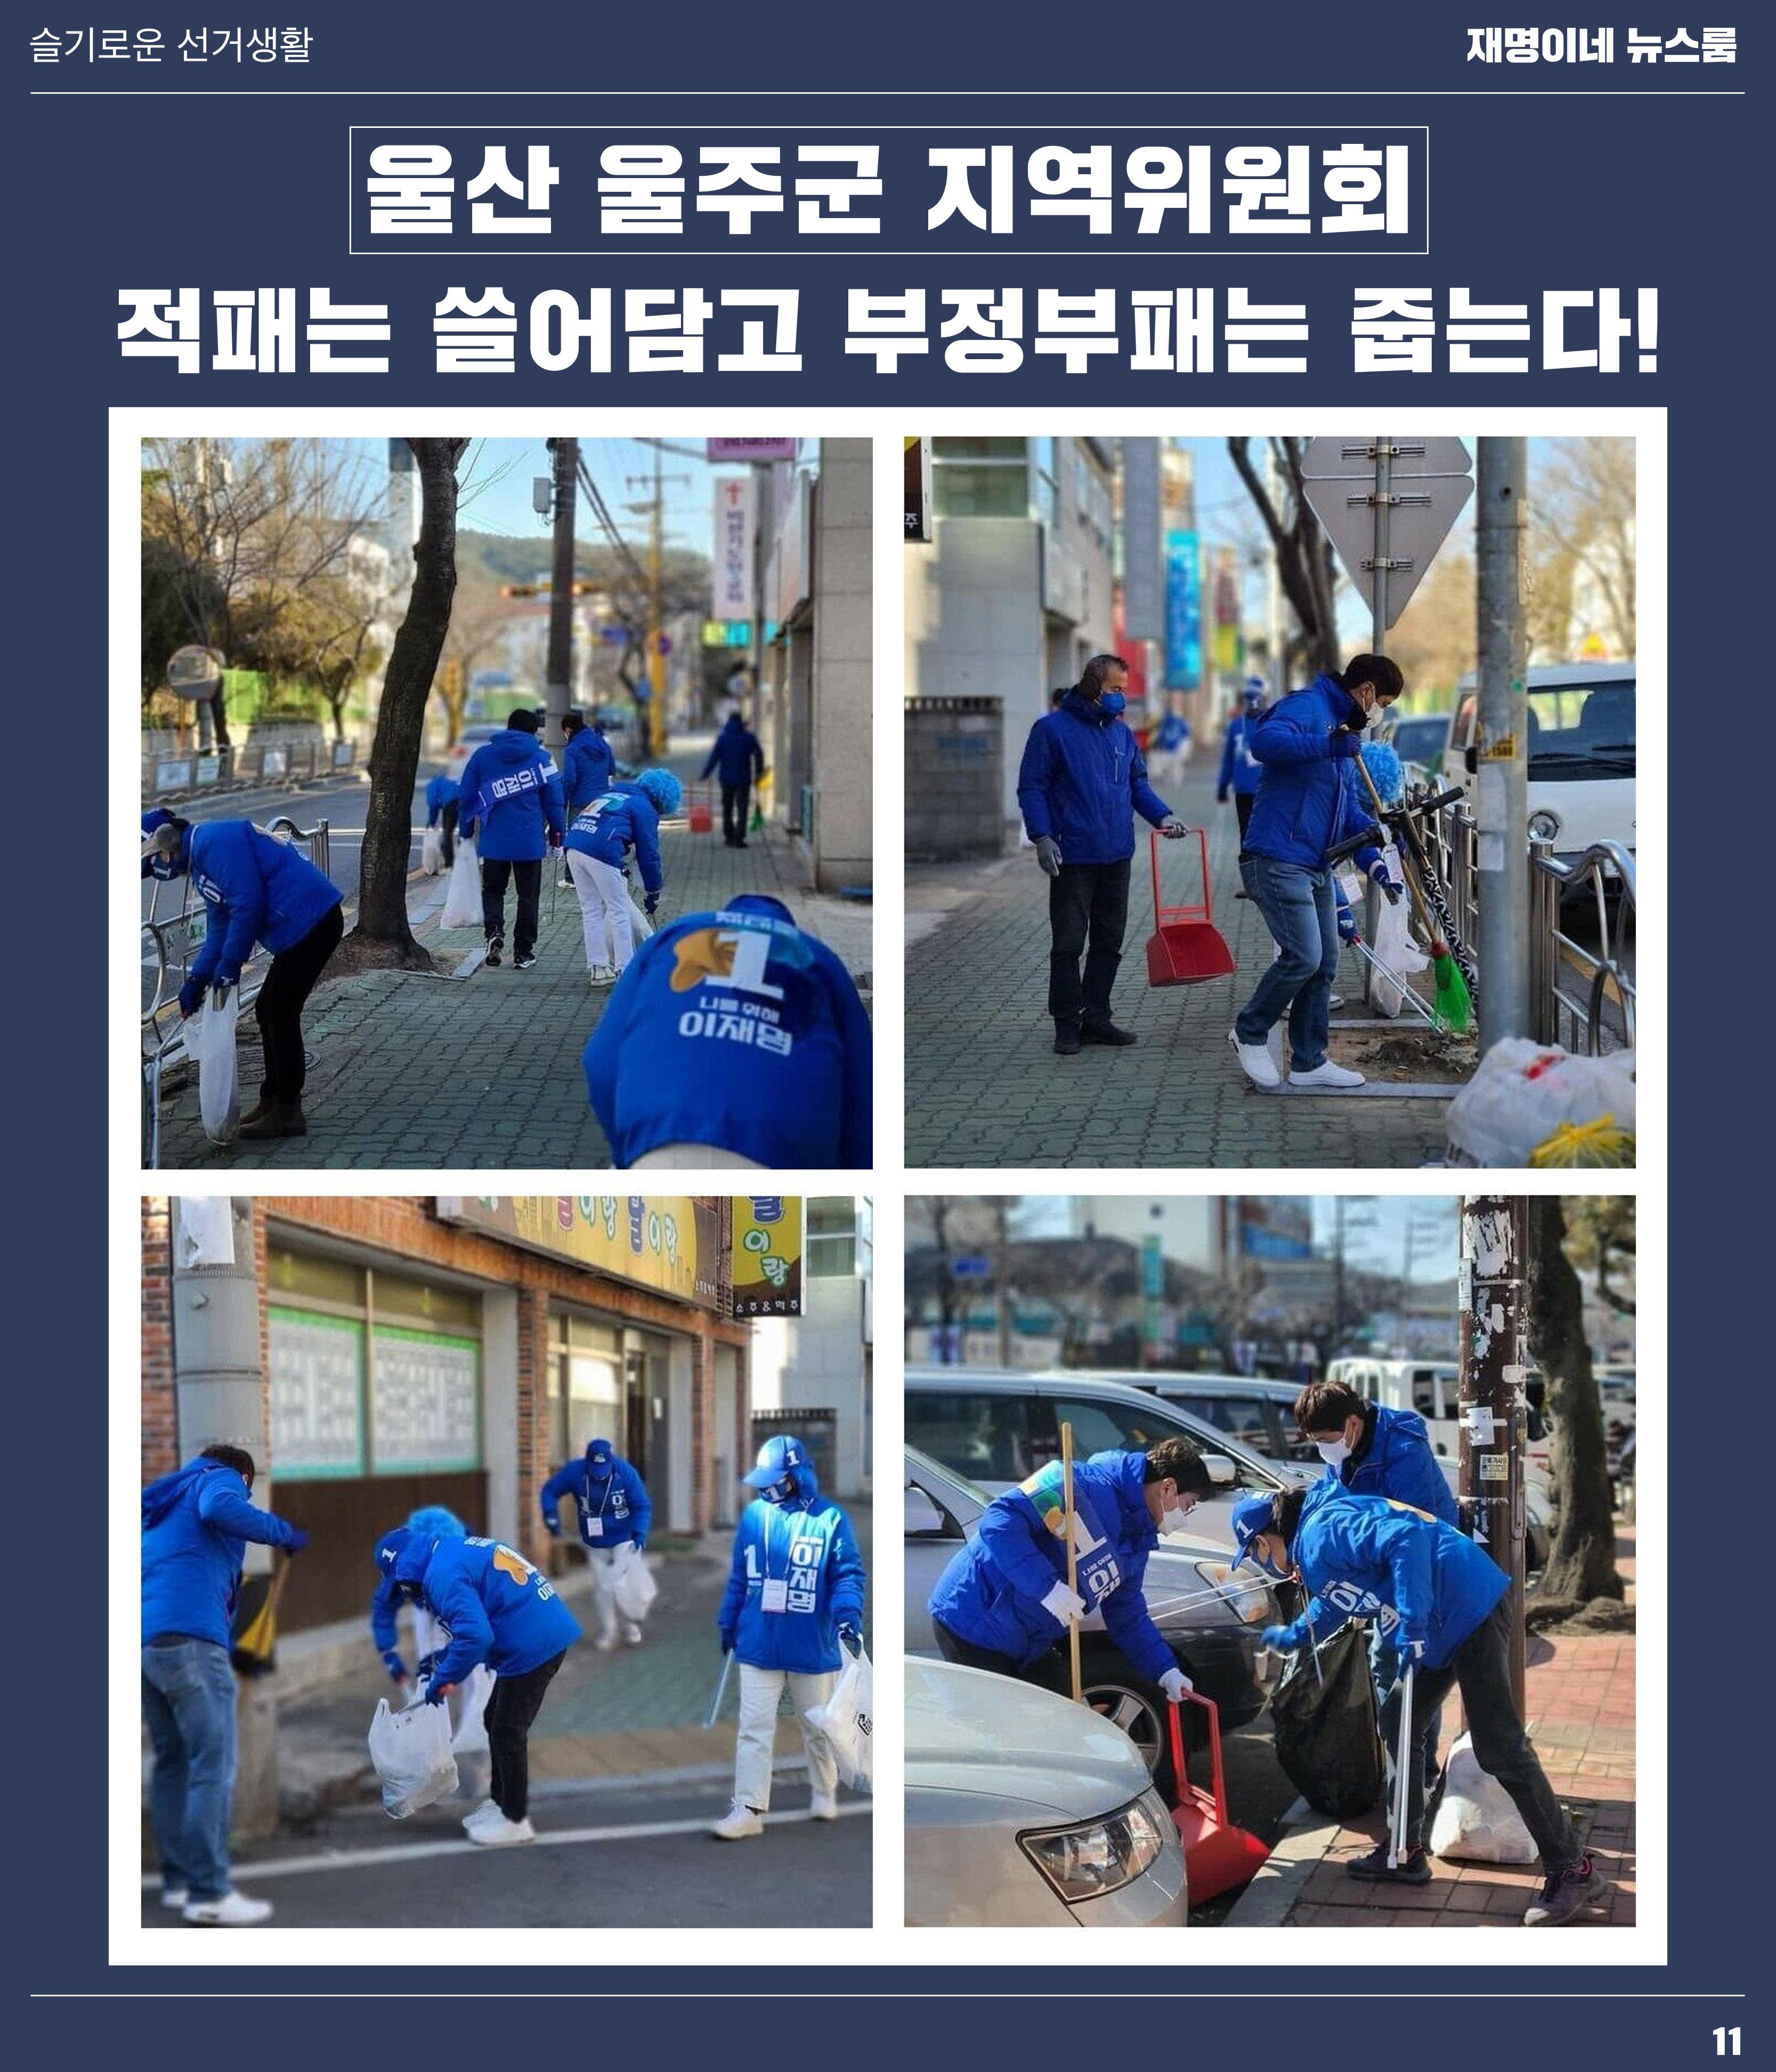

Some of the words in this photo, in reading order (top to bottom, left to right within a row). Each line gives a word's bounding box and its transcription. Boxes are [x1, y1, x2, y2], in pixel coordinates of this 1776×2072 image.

[491, 769, 534, 799] 이재명
[705, 930, 784, 1000] 1
[678, 1011, 793, 1056] 이재명
[787, 1450, 800, 1466] 1
[1236, 1519, 1254, 1539] 1
[382, 1548, 397, 1562] 1
[744, 1544, 762, 1579] 1
[788, 1543, 823, 1614] 이재명
